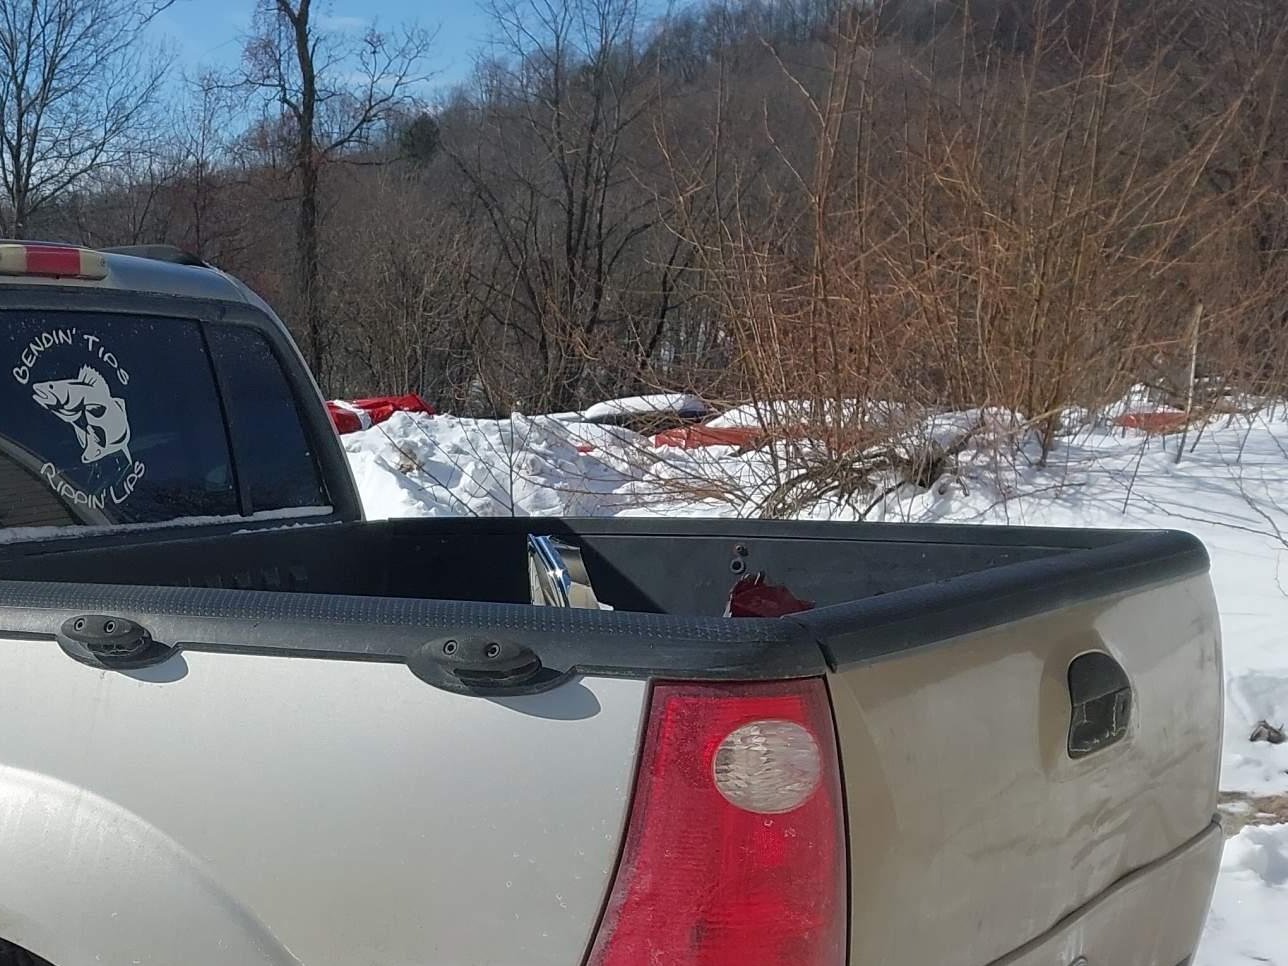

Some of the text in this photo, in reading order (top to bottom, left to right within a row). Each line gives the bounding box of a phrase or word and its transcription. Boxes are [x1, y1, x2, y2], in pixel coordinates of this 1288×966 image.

[12, 327, 130, 385] BENDIN' TIPS
[40, 461, 145, 509] RIPPIN' LIPS
